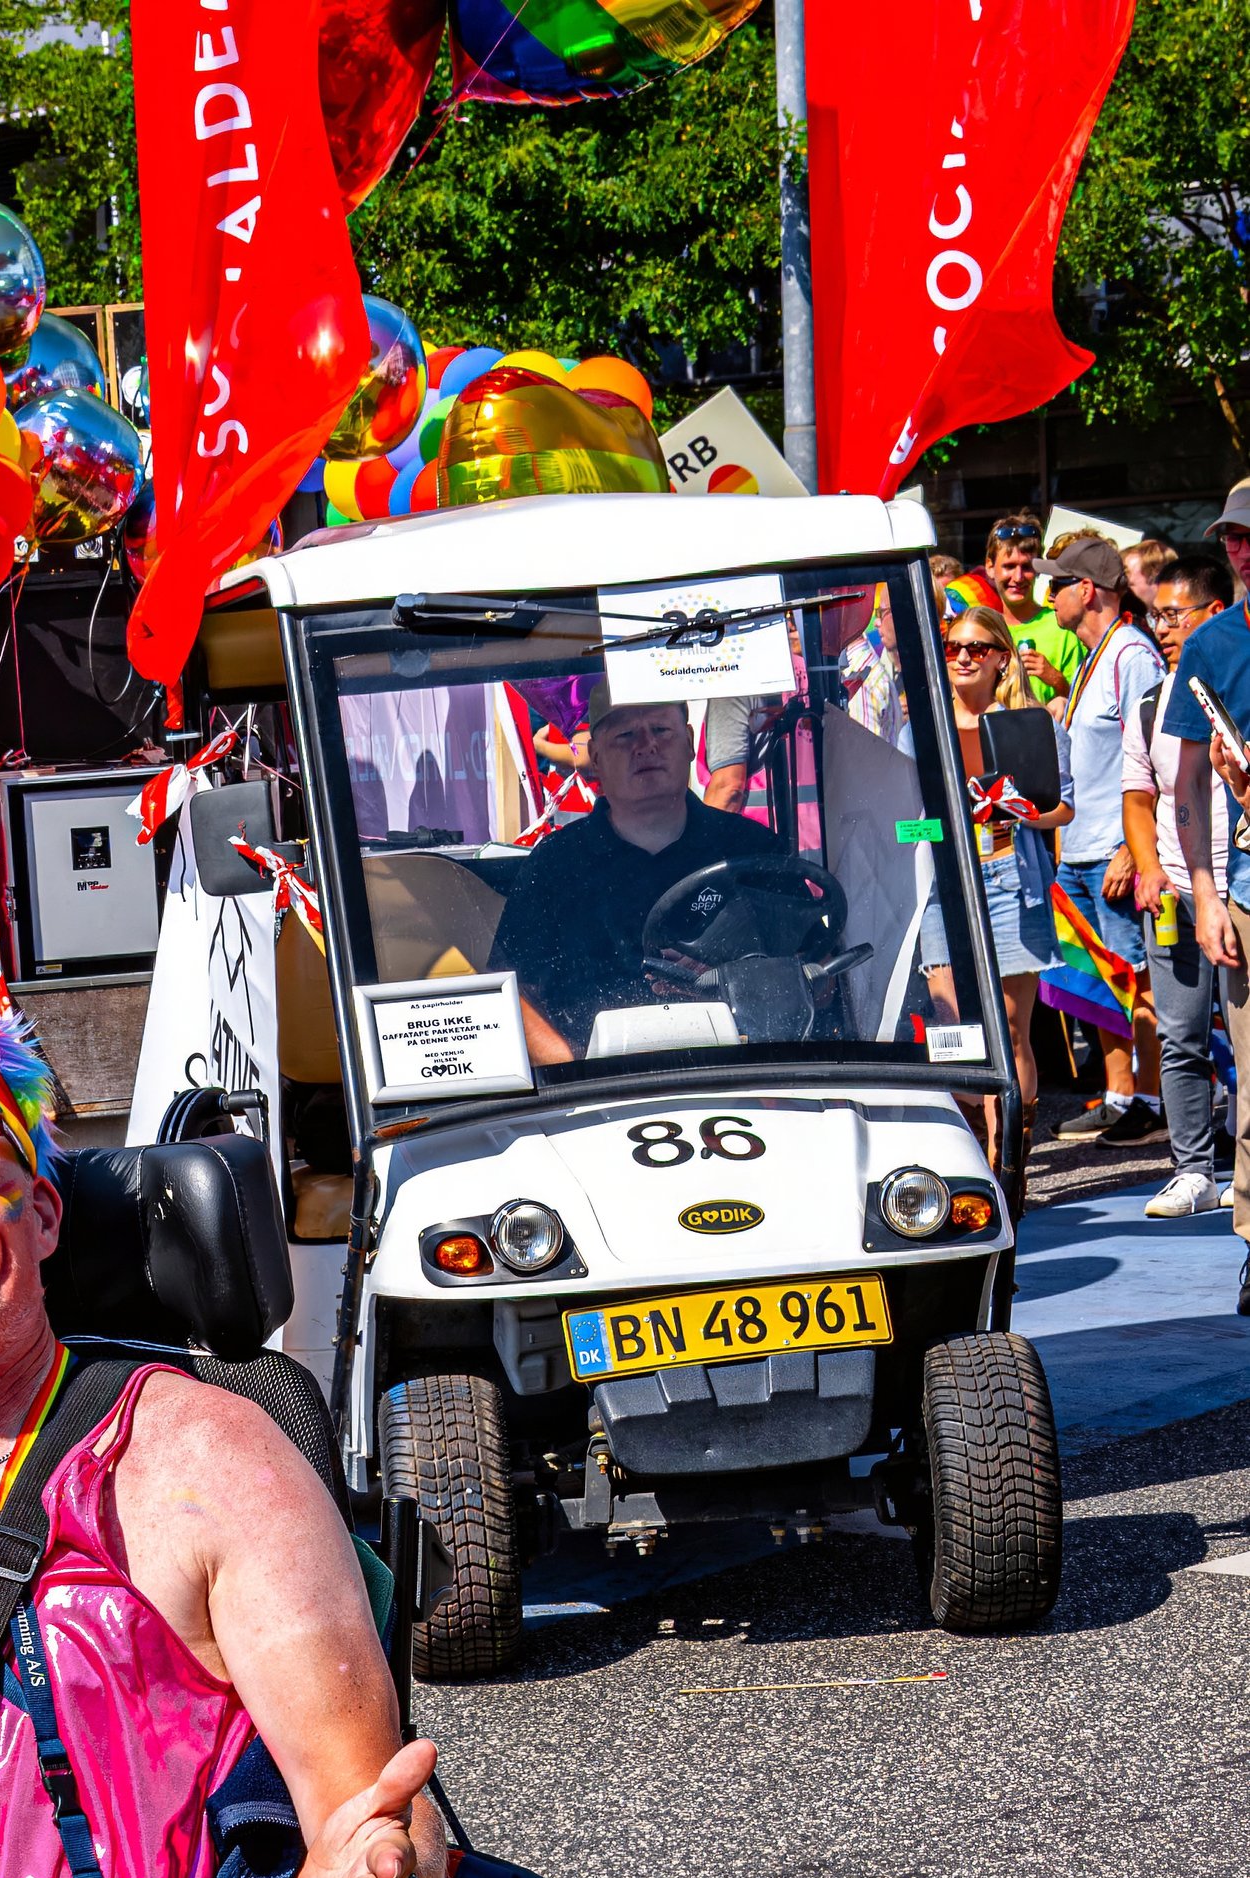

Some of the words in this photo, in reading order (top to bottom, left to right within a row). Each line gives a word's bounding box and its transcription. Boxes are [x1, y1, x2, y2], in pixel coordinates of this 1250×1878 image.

[667, 435, 719, 483] RB
[659, 663, 740, 677] Socialdemokratiet
[407, 1019, 440, 1030] BRUG
[444, 1015, 472, 1026] IKKE
[382, 1030, 430, 1041] GAFFATAPE
[432, 1024, 481, 1035] PAKKETAPE
[420, 1037, 449, 1045] DENNE
[452, 1034, 478, 1042] VOGN!
[434, 1056, 457, 1064] HILSEN
[609, 1307, 687, 1362] BN
[702, 1296, 768, 1347] 48
[779, 1285, 877, 1340] 961
[579, 1349, 602, 1366] DK
[25, 1658, 46, 1687] A/S
